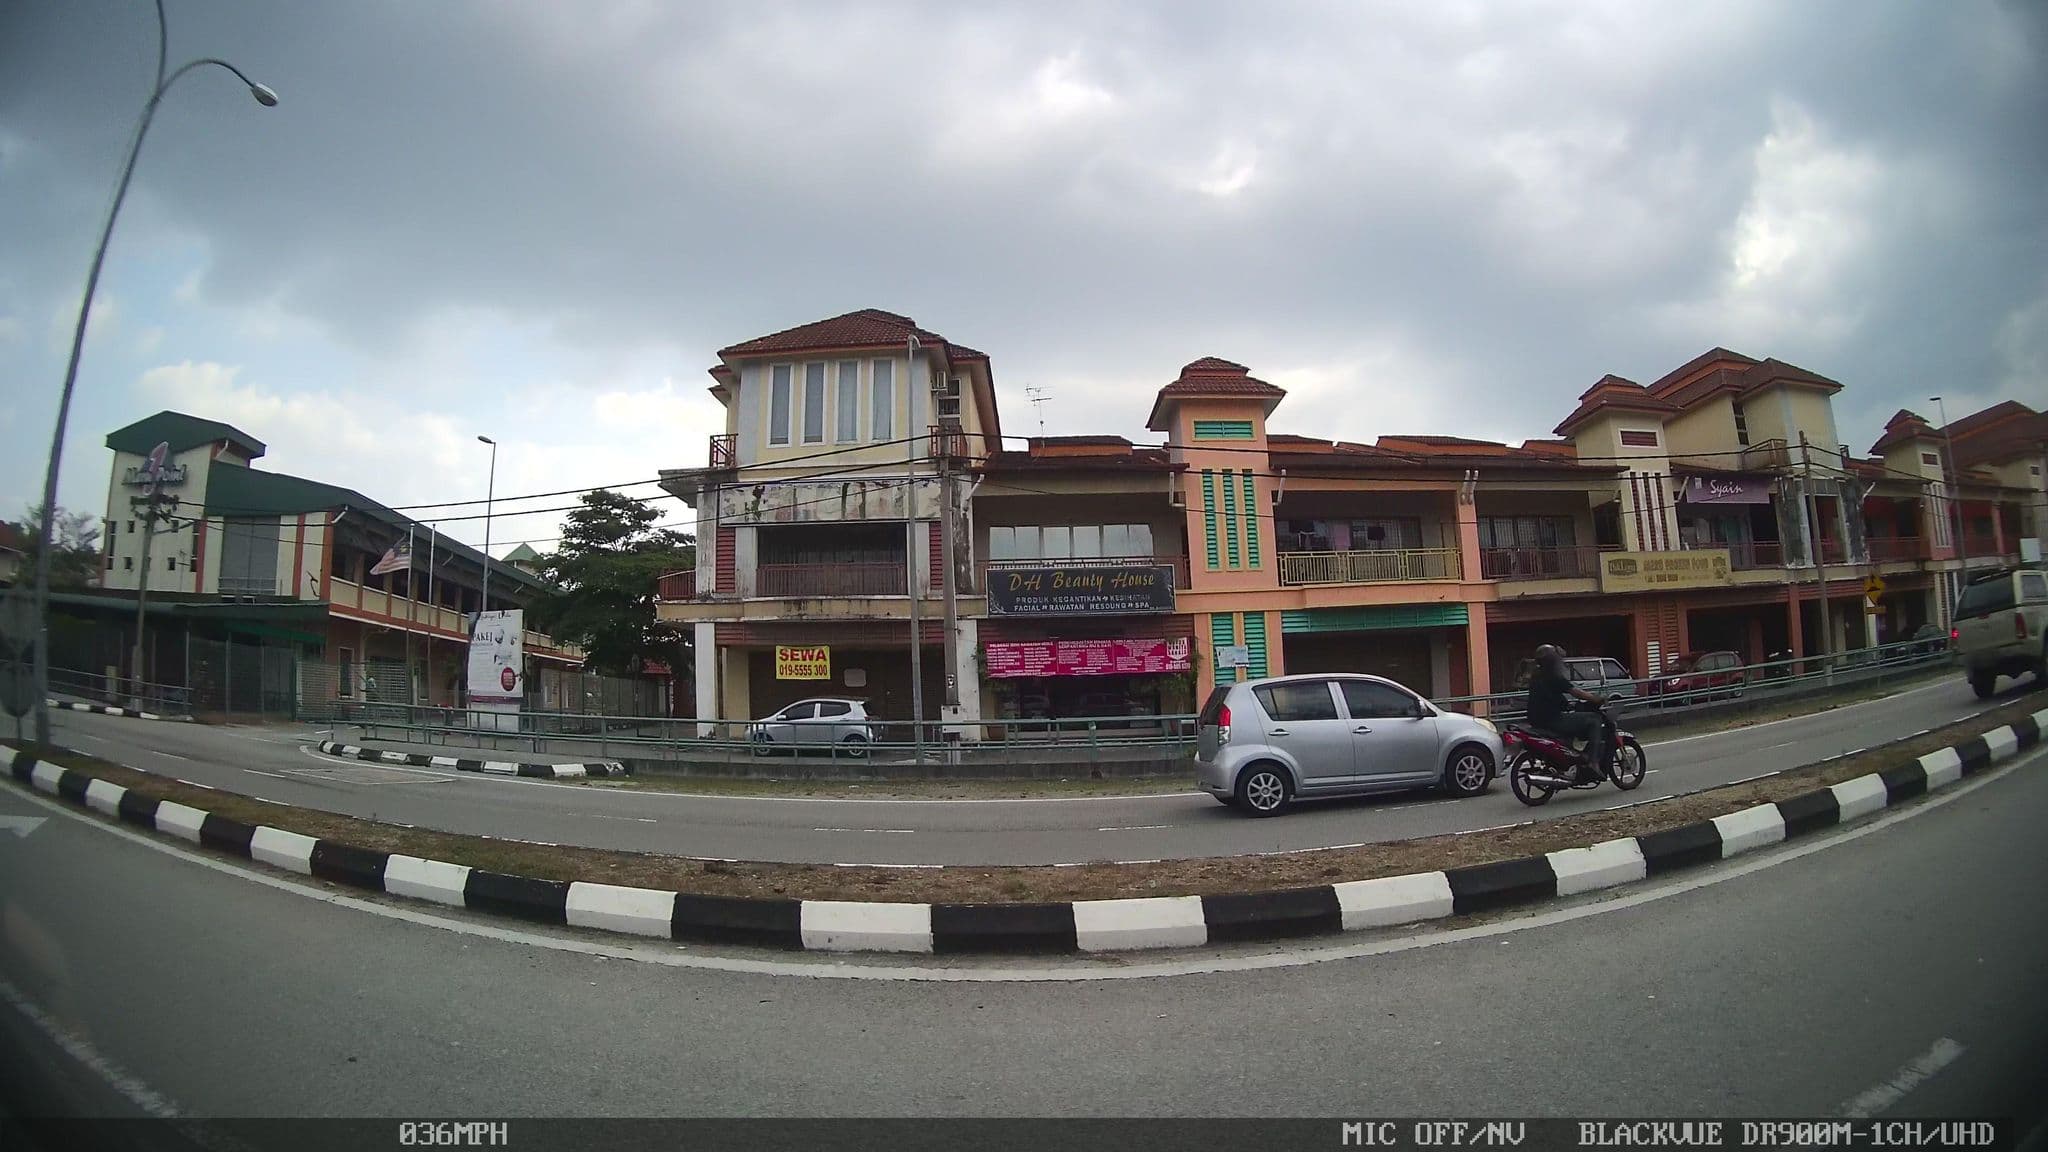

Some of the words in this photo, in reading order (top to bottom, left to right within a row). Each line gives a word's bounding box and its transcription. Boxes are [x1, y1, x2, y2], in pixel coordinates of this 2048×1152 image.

[1710, 479, 1744, 497] Syain
[1051, 571, 1104, 592] Beauty
[1111, 571, 1155, 590] House
[1015, 596, 1049, 604] PRODUK
[1052, 595, 1102, 604] KECANTIKAN
[1014, 604, 1041, 612] FACIAL
[1049, 603, 1085, 611] RAWATAN
[779, 648, 827, 661] SEWA
[779, 664, 812, 676] 019-5555
[814, 664, 828, 676] 300
